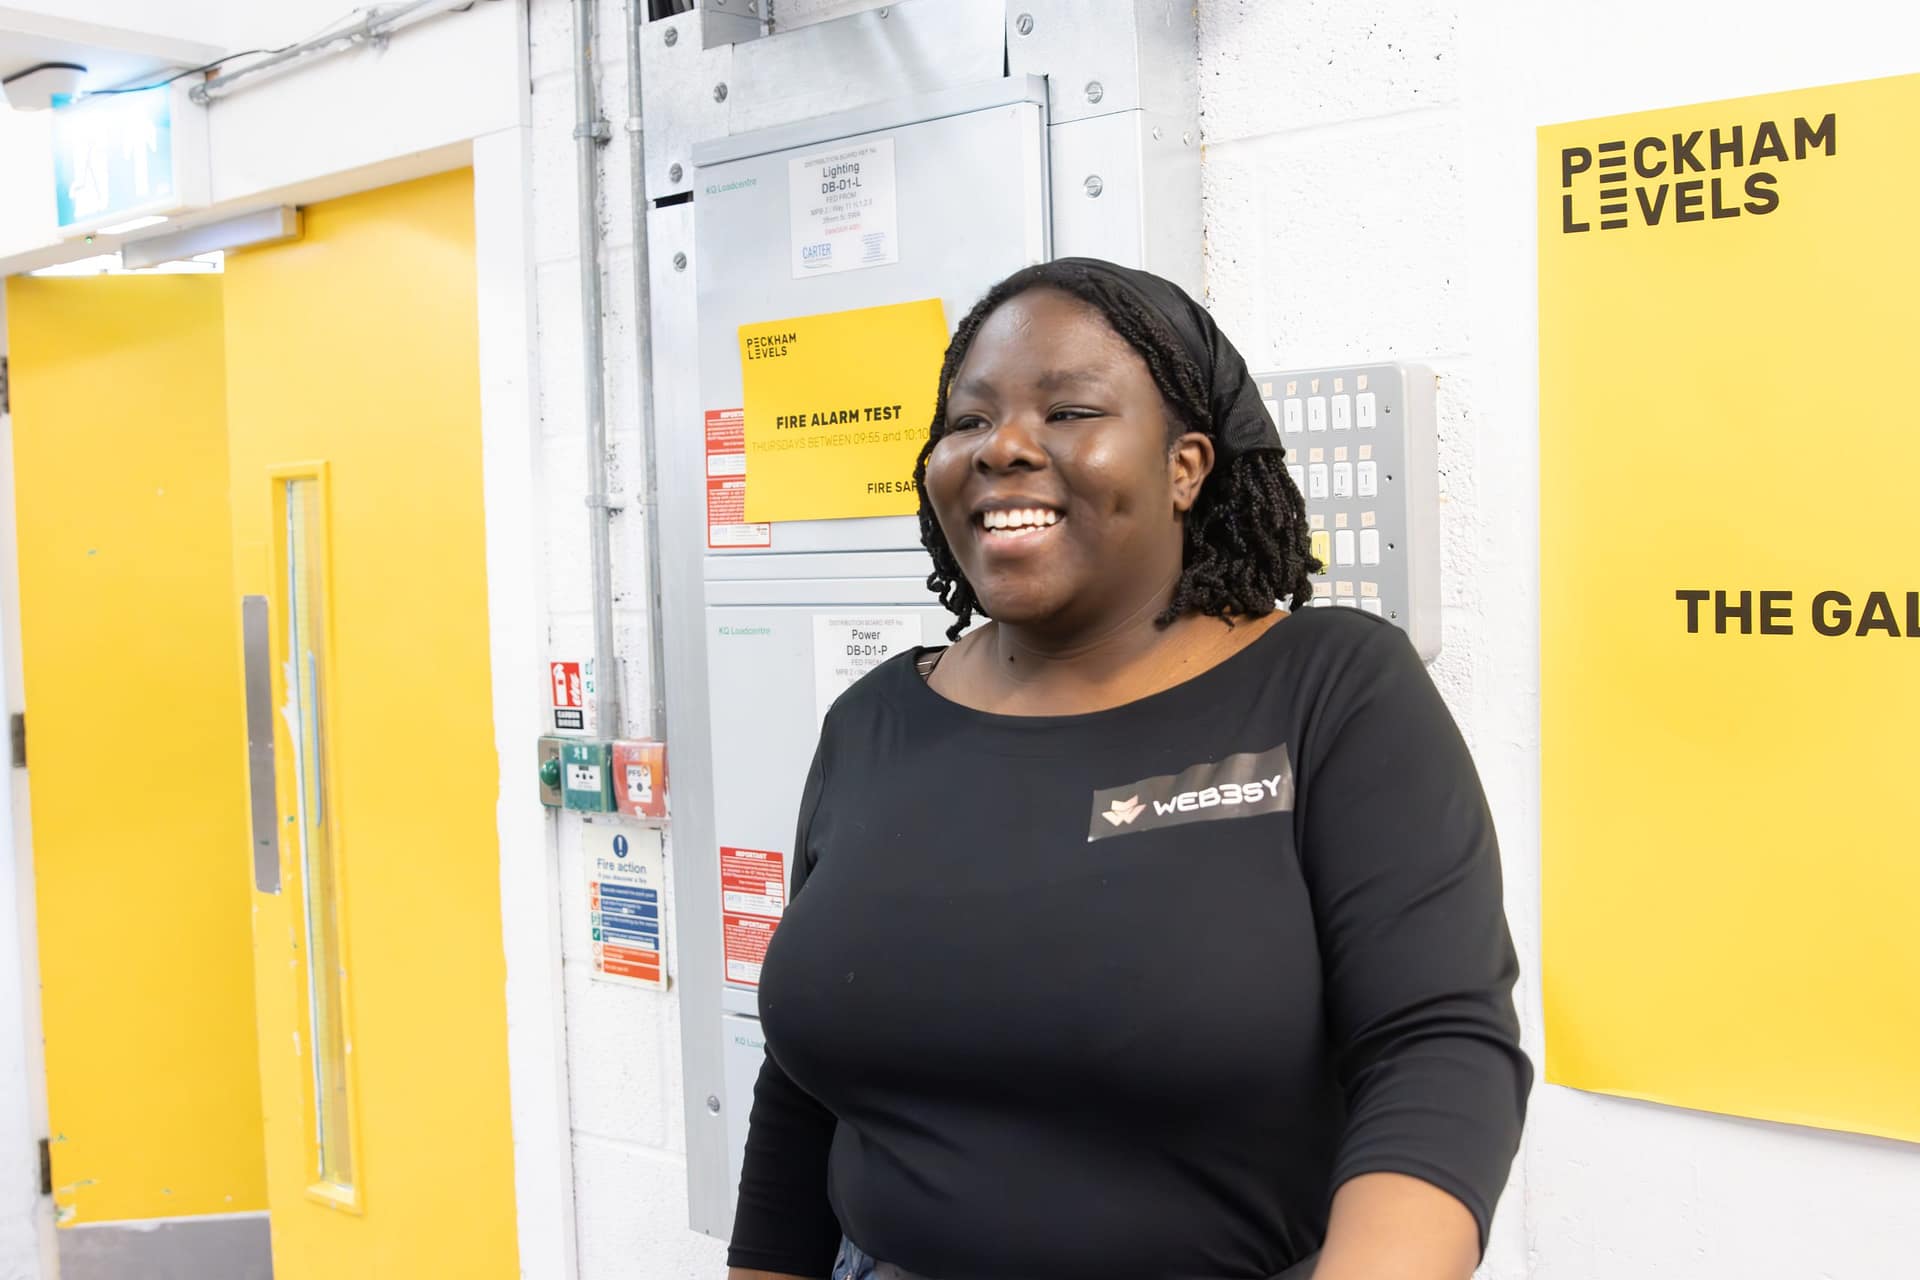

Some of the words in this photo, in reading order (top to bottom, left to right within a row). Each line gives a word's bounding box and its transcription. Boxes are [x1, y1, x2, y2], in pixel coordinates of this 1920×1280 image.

[1561, 112, 1837, 188] PECKHAM
[822, 163, 860, 179] Lighting
[821, 177, 863, 194] DB-D1-L
[1561, 171, 1780, 234] LEVELS
[746, 332, 797, 349] PECKHAM
[748, 345, 788, 360] LEVELS
[776, 414, 807, 430] FIRE
[811, 409, 860, 427] ALARM
[864, 405, 902, 422] TEST
[752, 438, 806, 453] THURSDAYS
[807, 433, 852, 449] BETWEEN
[853, 430, 881, 445] 09:55
[882, 430, 901, 442] and
[867, 481, 892, 494] FIRE
[1675, 589, 1794, 636] THE
[851, 629, 881, 640] Power
[846, 644, 888, 656] DB-D1-P
[1152, 774, 1282, 817] WEB3SY
[597, 857, 615, 871] Fire
[617, 861, 647, 875] action
